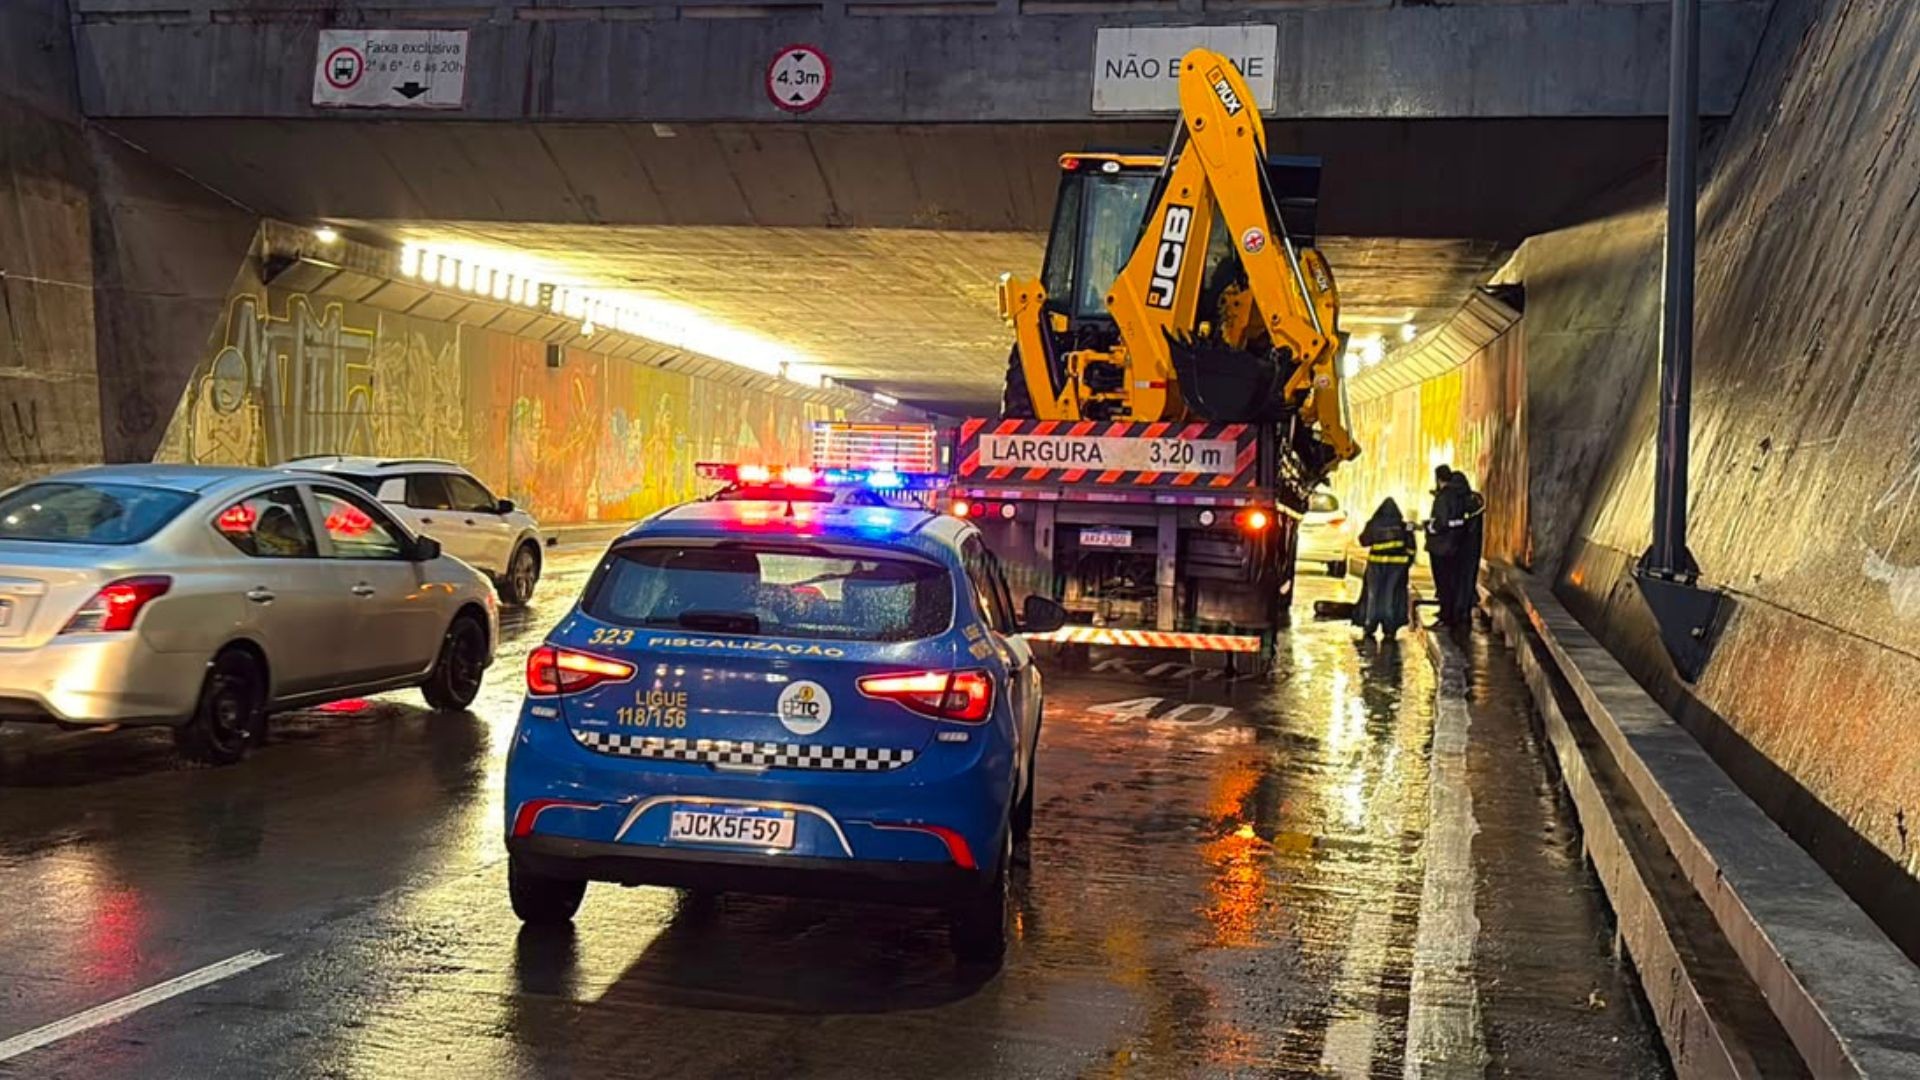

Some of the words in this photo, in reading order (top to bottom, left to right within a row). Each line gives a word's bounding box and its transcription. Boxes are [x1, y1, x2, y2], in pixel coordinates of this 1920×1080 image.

[366, 40, 398, 54] Faixa
[402, 41, 460, 55] exclusiva
[440, 60, 463, 73] 20h
[1106, 53, 1160, 79] NÃO
[1152, 207, 1191, 307] JCB
[992, 439, 1103, 463] LARGURA
[1150, 441, 1194, 467] 3,20
[1201, 447, 1222, 465] m
[588, 628, 635, 646] 323
[648, 636, 845, 658] FISCALIZAÇÃO
[635, 690, 688, 709] LIGUE
[617, 708, 687, 728] 118/156
[681, 814, 781, 842] JCK5F59
